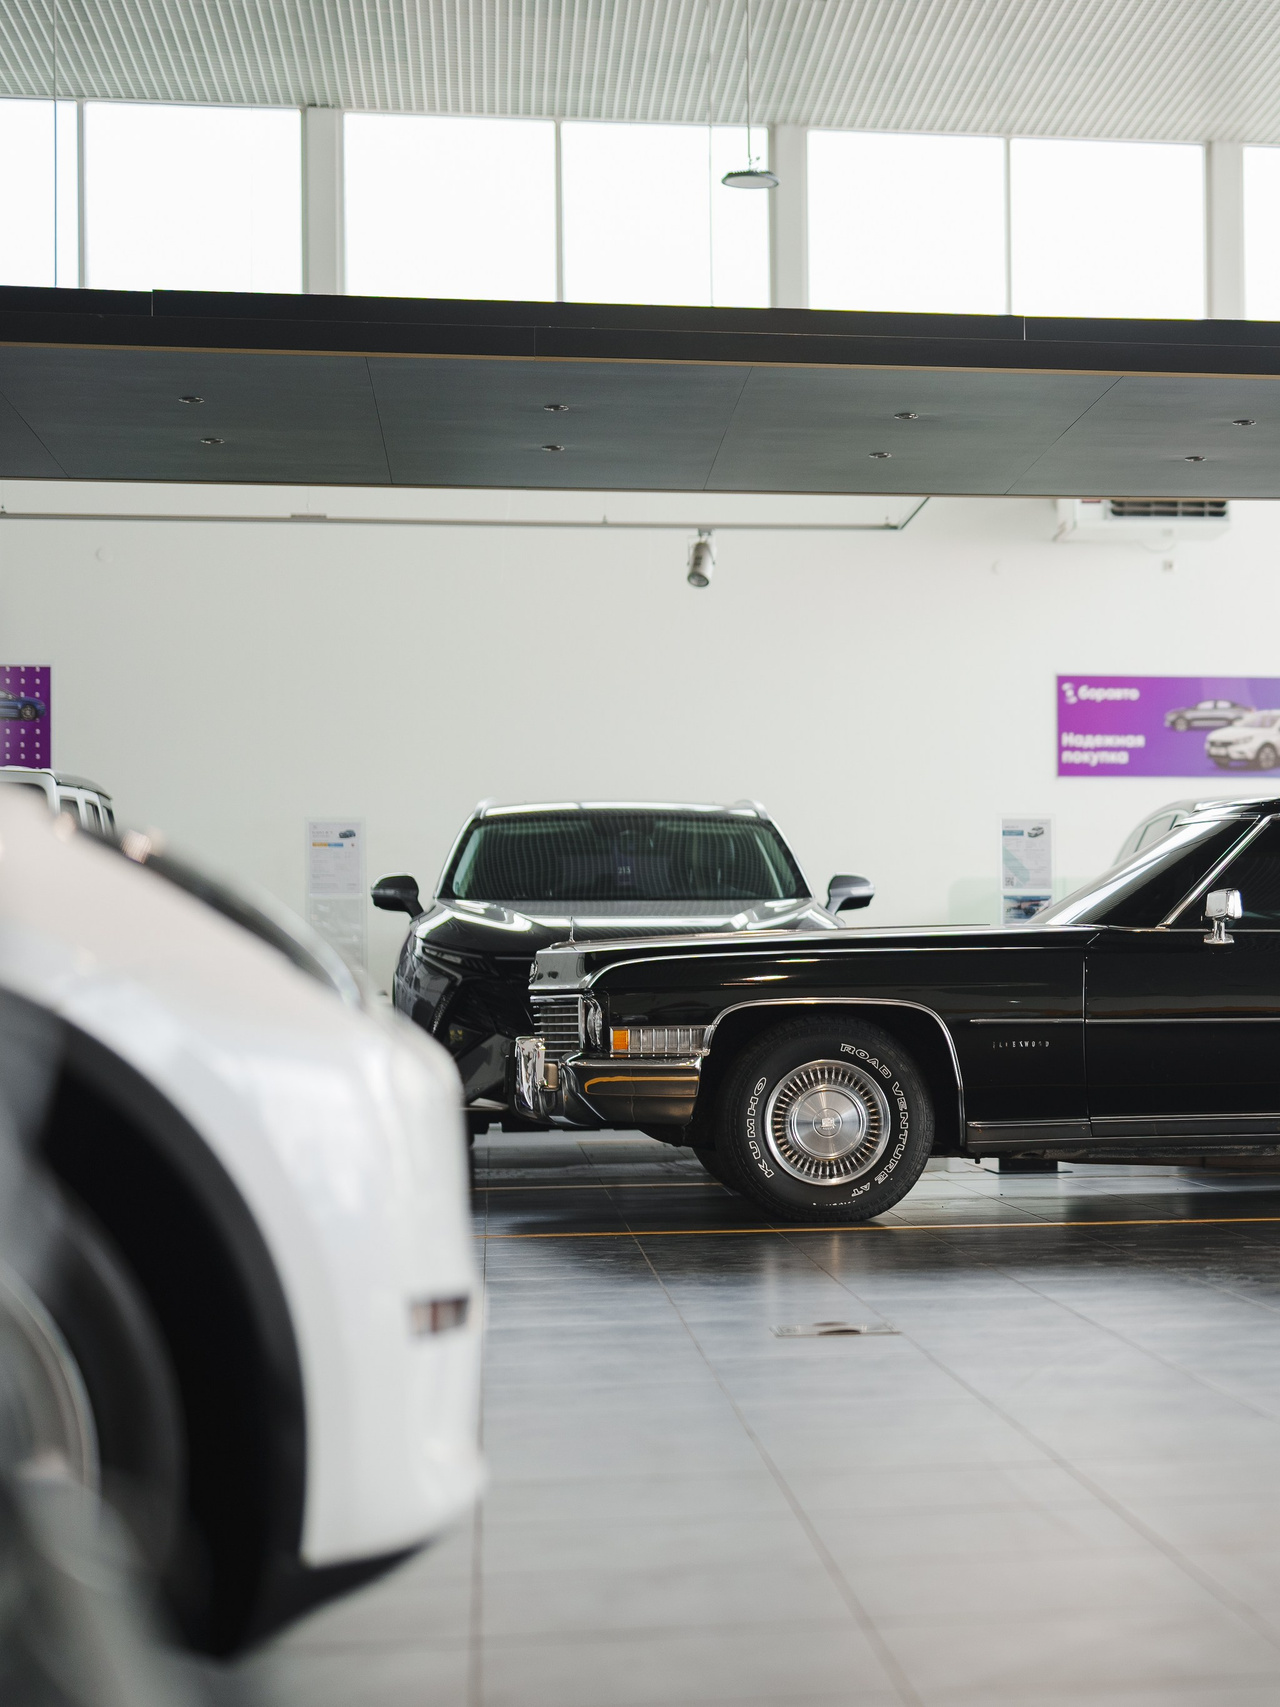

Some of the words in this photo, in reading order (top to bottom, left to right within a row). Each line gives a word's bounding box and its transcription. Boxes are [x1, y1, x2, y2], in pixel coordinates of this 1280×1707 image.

[1061, 732, 1146, 749] Надежная
[1061, 750, 1129, 767] покупка
[840, 1043, 892, 1079] ROAD
[746, 1077, 774, 1178] KUMHO
[874, 1081, 909, 1184] VENTURE
[851, 1182, 871, 1197] AT
